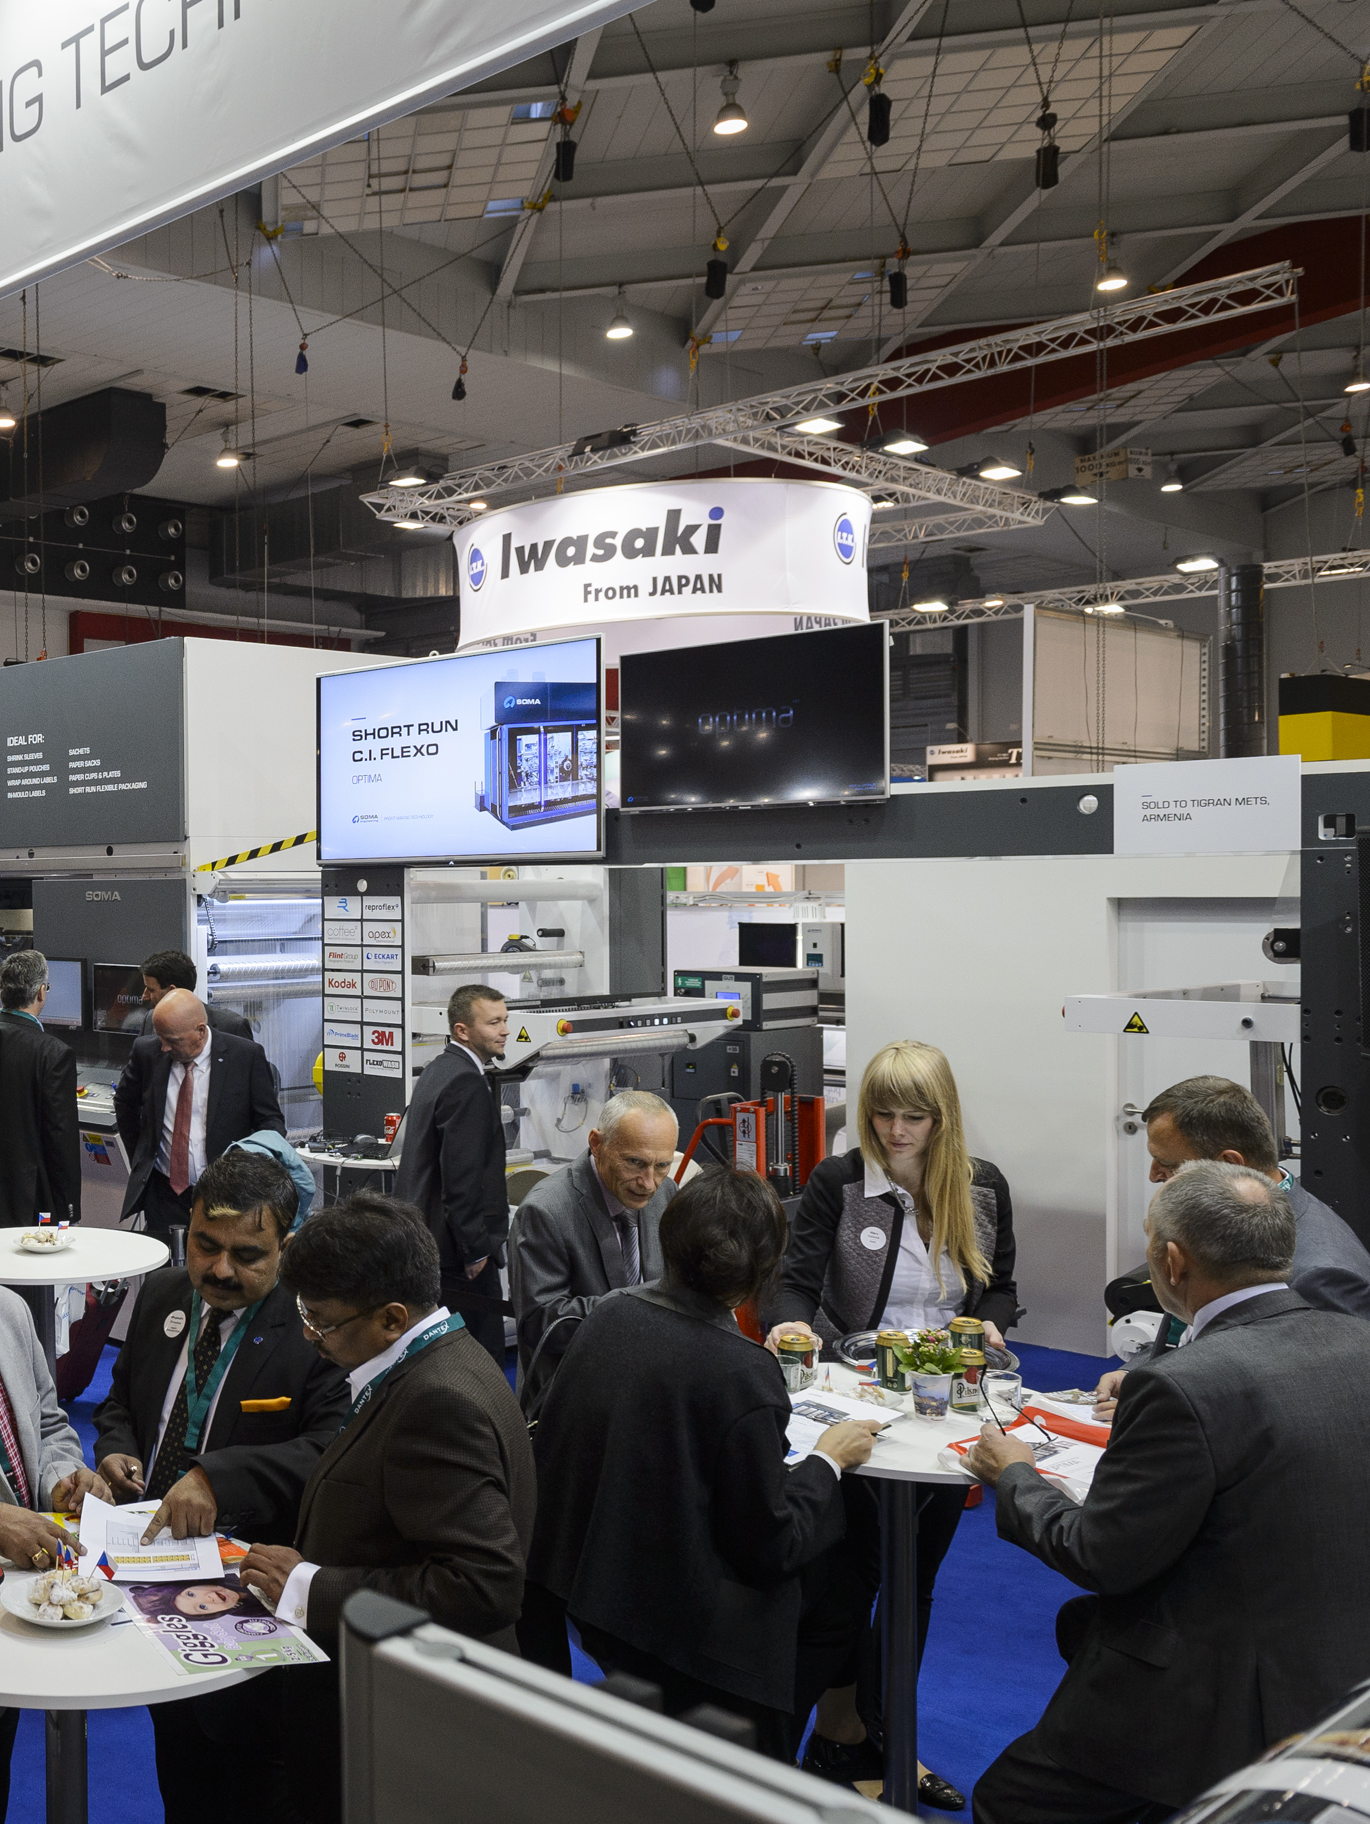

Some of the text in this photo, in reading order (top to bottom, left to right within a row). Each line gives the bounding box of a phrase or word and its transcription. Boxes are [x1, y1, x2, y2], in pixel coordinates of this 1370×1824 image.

[61, 0, 241, 110] TECH
[500, 506, 724, 580] Iwasaki
[583, 573, 724, 603] From JAPAN
[516, 697, 541, 705] SOMA
[352, 719, 459, 742] SHORT RUN
[7, 733, 45, 747] IDEAL FOR:
[7, 752, 43, 762] SHRINK SLEEVES
[68, 747, 90, 756] SACHETS
[352, 743, 439, 763] C.I. FLEXO
[29, 764, 50, 772] POUCHES
[68, 759, 101, 769] PAPER SACKS
[7, 776, 58, 786] WRAP AROUND LABELS
[68, 774, 85, 782] PAPER
[85, 772, 98, 780] CUPS
[103, 770, 121, 779] PLATES
[352, 774, 382, 785] OPTIMA
[29, 789, 46, 798] LABELS
[68, 781, 148, 795] SHORT RUN FLEXIBLE PACKAGING
[1141, 796, 1270, 810] SOLD TO TIGRAN METS,
[1141, 813, 1193, 823] ARMENIA
[85, 891, 121, 902] SOMA
[368, 931, 392, 940] apex
[328, 978, 358, 989] Kodak
[371, 1030, 394, 1047] 3M
[423, 1320, 450, 1341] DANTEX
[354, 1383, 373, 1414] DANTEX
[160, 1616, 229, 1665] Giggles
